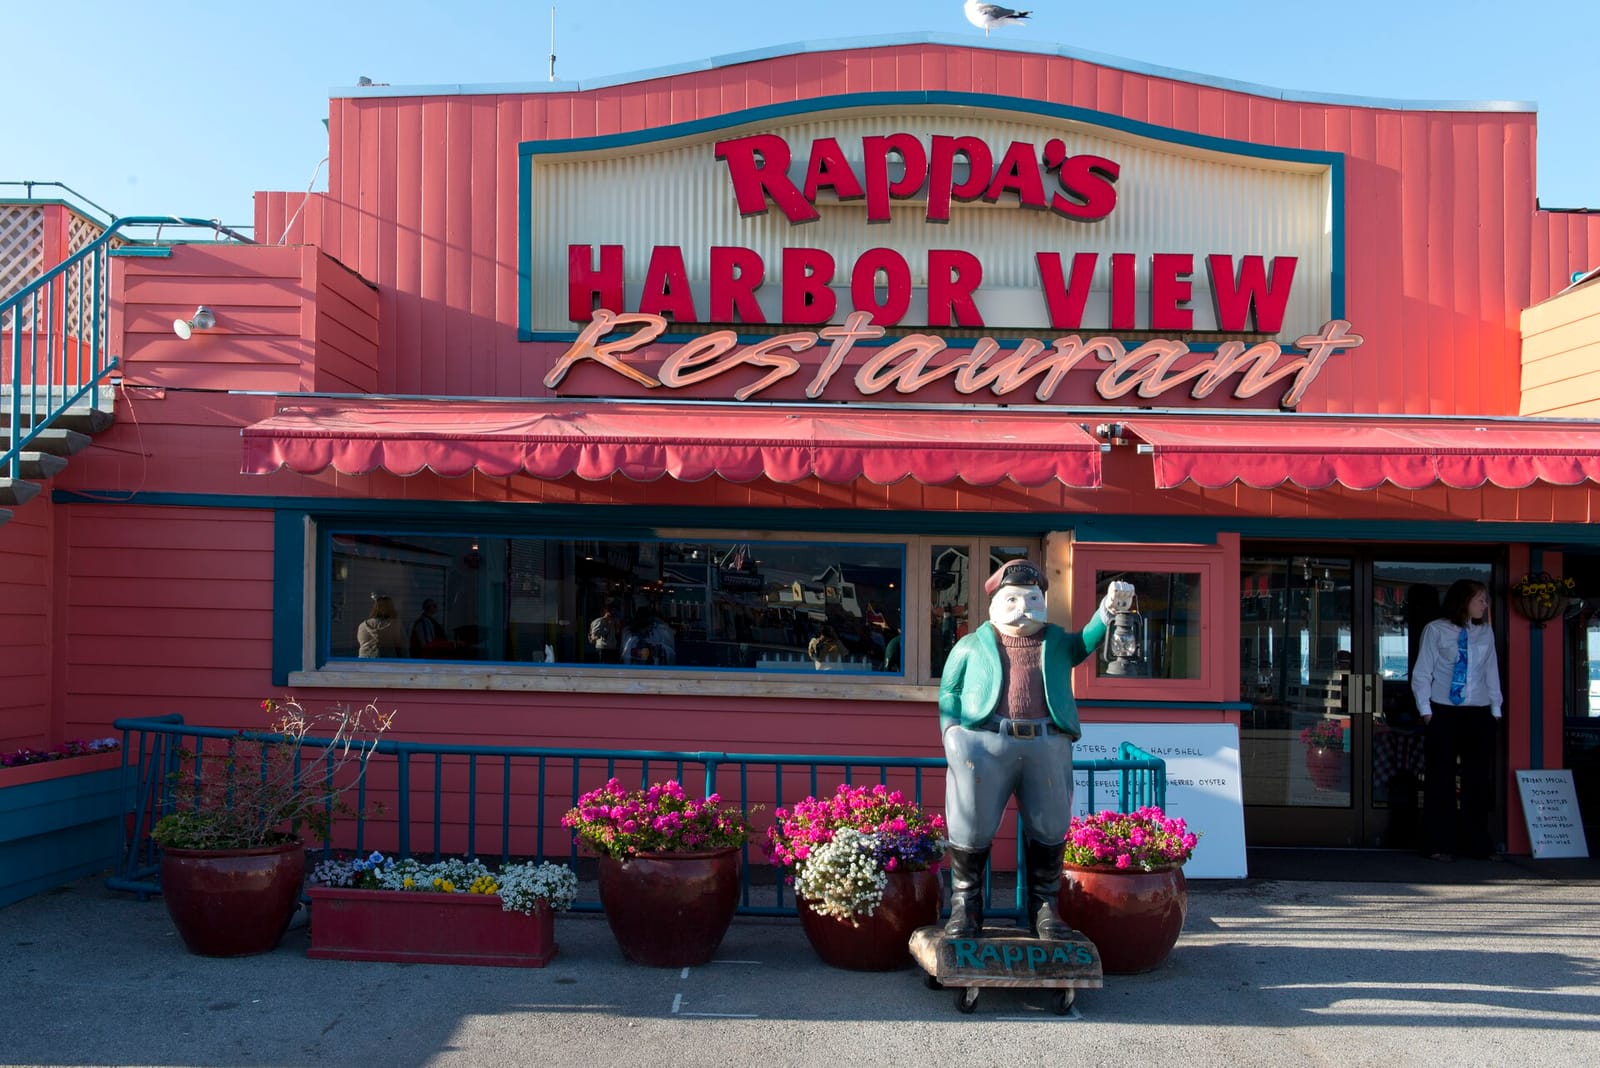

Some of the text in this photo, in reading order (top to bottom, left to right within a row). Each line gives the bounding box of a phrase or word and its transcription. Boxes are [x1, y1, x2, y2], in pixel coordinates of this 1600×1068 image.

[568, 244, 1298, 335] HARBOR VIEW
[543, 308, 1364, 408] Restaurant
[1151, 747, 1172, 755] HALF
[1175, 748, 1203, 756] SHELL
